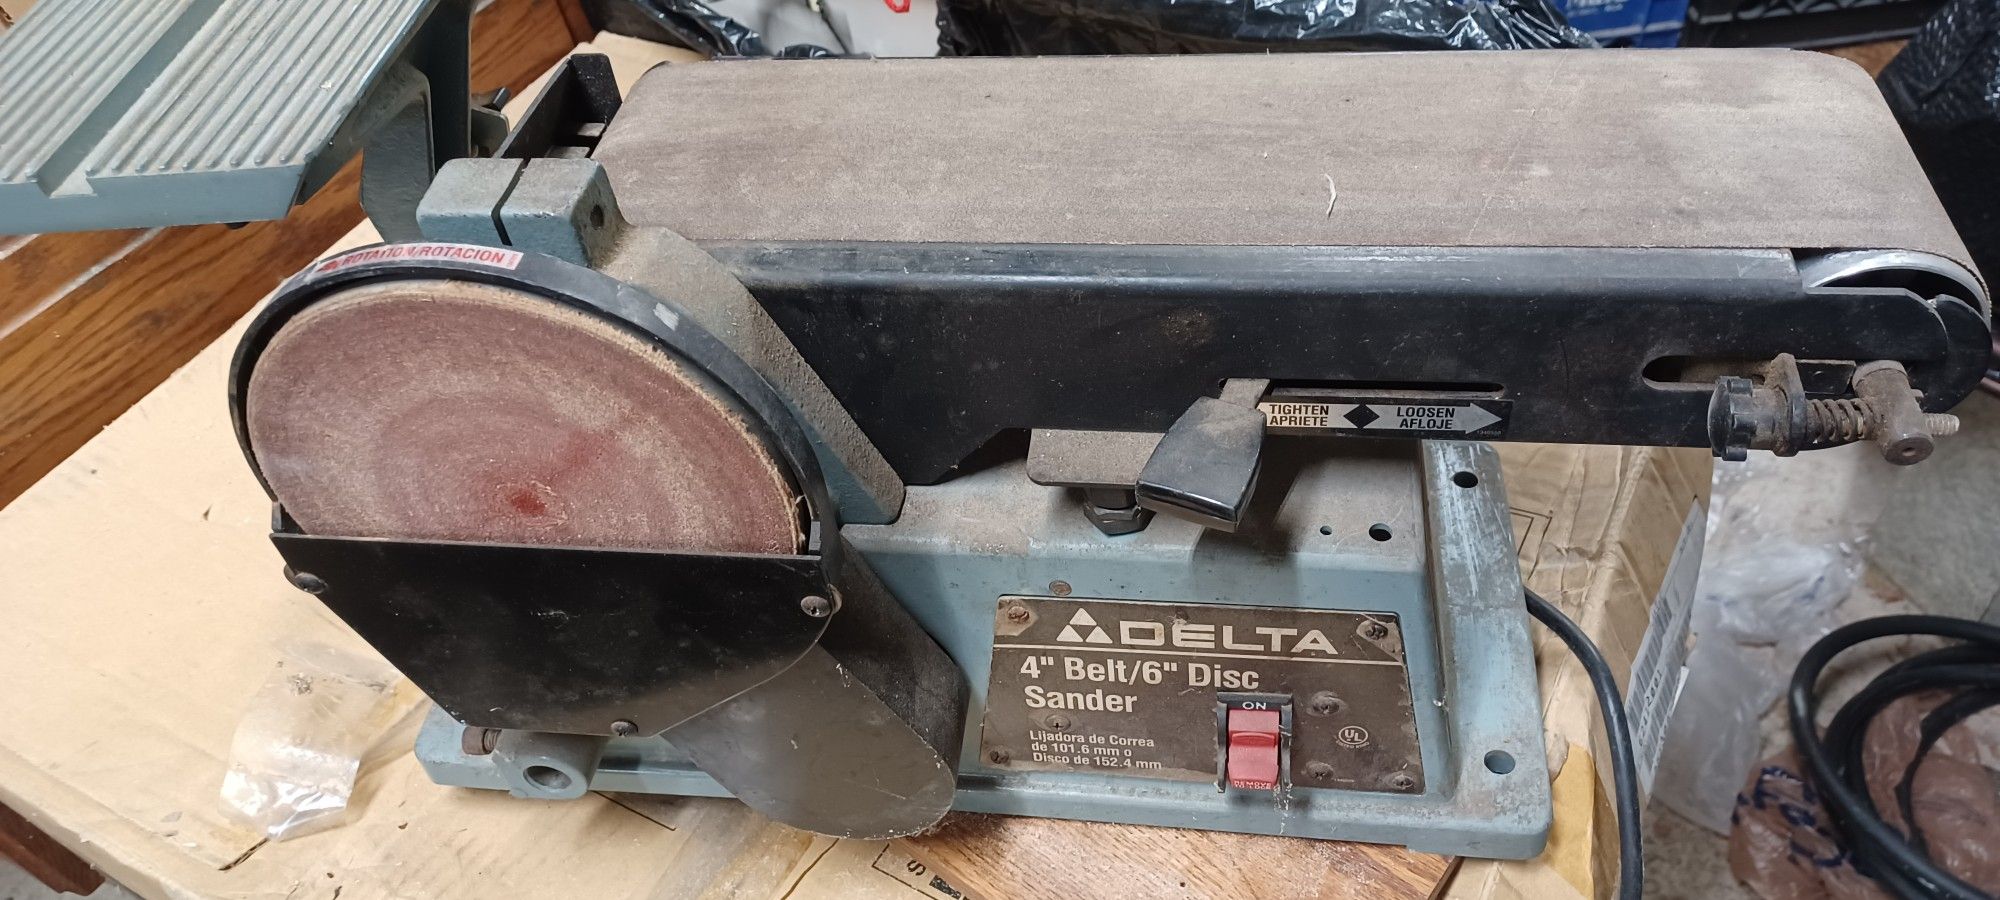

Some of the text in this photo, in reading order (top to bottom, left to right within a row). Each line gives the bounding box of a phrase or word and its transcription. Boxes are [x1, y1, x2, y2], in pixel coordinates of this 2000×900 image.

[1269, 404, 1329, 416] TIGHTEN
[1397, 407, 1455, 418] LOOSEN
[1269, 415, 1328, 427] APRIETE
[1399, 418, 1453, 430] AFLOJE
[1119, 620, 1339, 655] DELTA
[1020, 654, 1259, 690] 4" Belt/6" Disc
[1024, 686, 1138, 713] Sander
[1242, 701, 1267, 711] ON
[1029, 730, 1155, 747] Lijadora de Correa
[1031, 742, 1132, 756] de 101.6 mm o
[1033, 753, 1162, 769] Disco de 152.4 mm
